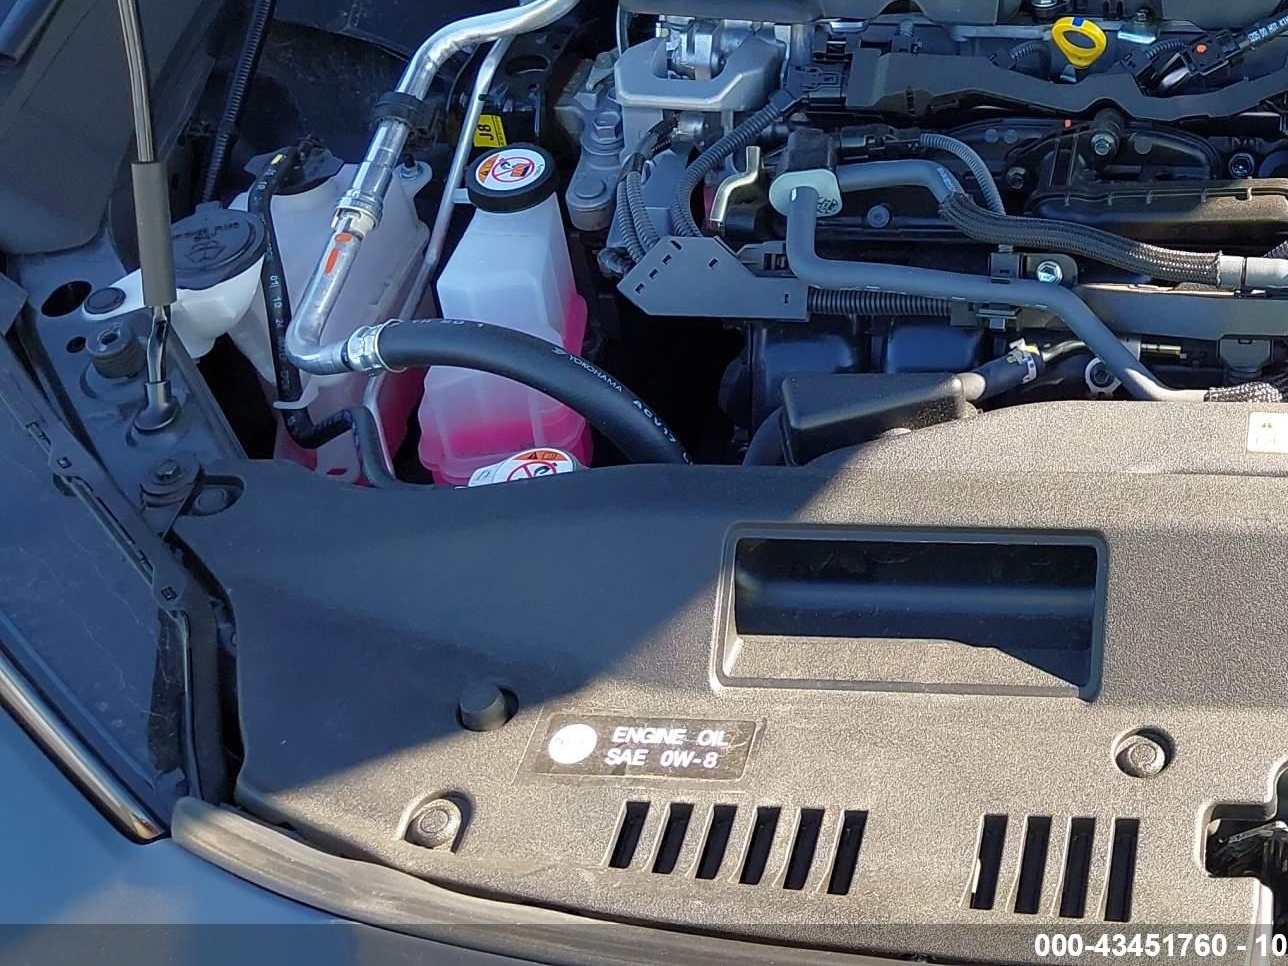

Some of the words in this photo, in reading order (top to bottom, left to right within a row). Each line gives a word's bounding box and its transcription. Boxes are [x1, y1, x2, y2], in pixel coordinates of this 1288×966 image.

[478, 124, 494, 140] J8
[568, 354, 623, 394] YOKOHAMA
[611, 726, 687, 745] ENGINE
[696, 729, 730, 747] OIL
[604, 747, 650, 766] SAE
[660, 750, 719, 769] 0W-8
